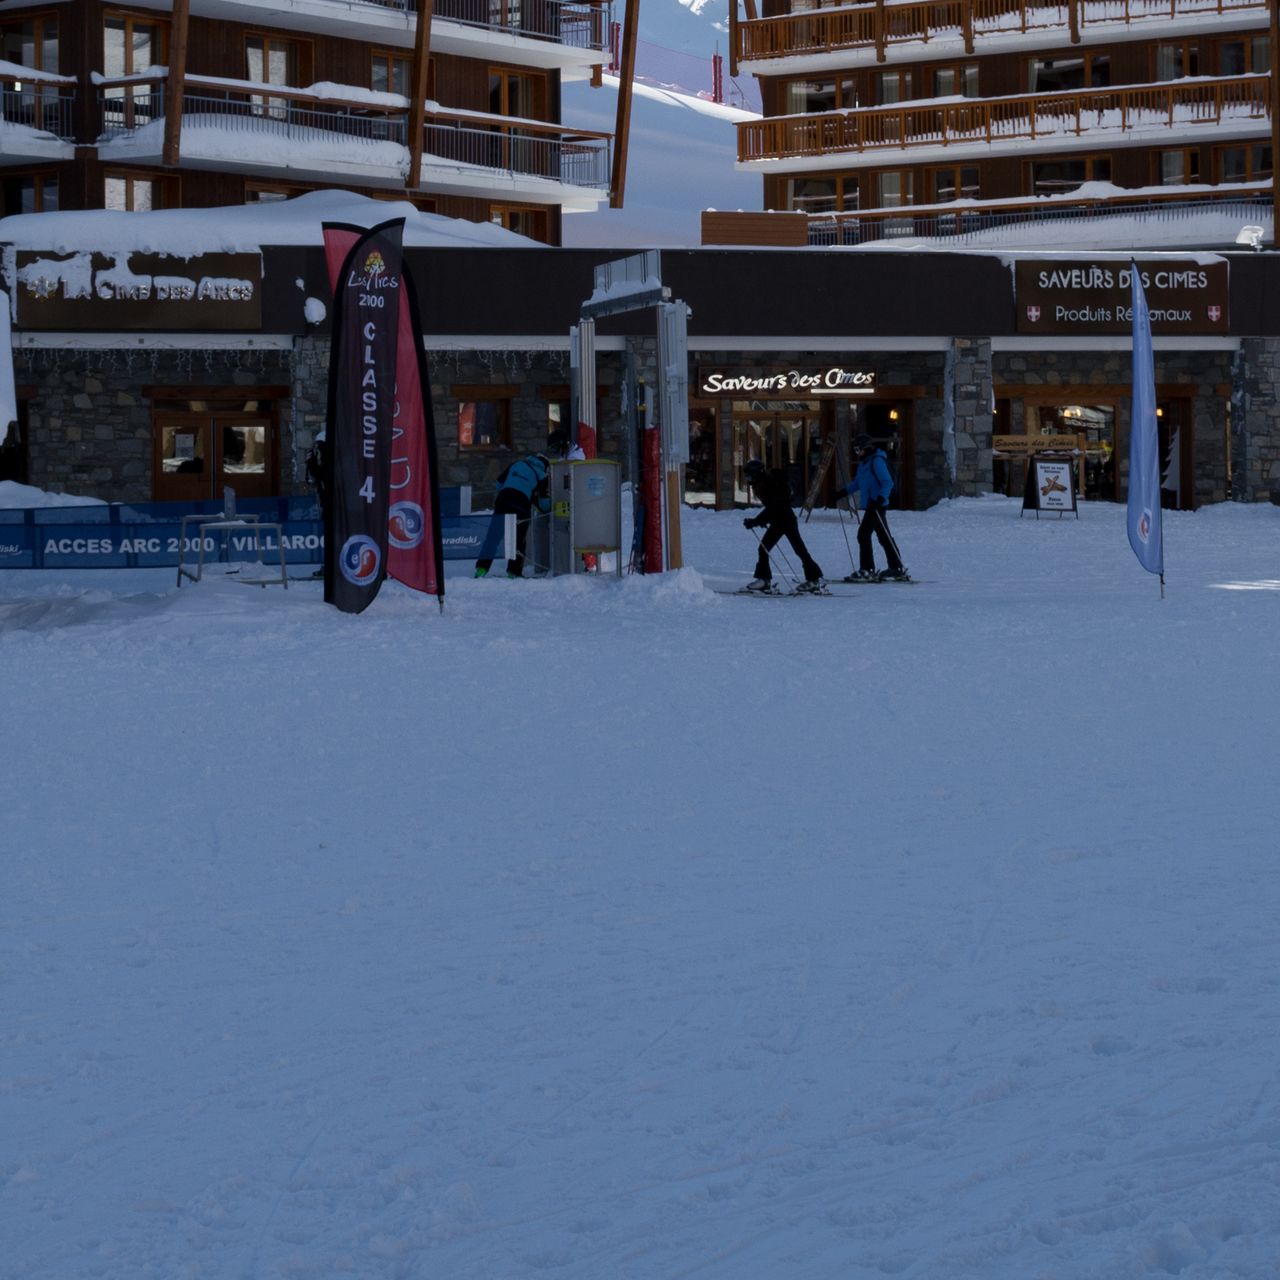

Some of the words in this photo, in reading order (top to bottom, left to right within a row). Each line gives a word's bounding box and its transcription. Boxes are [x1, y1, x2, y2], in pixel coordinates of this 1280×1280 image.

[1038, 269, 1114, 289] SAVEURS
[1118, 269, 1150, 289] DS
[1154, 270, 1208, 289] CIMES
[1055, 305, 1112, 322] Produits
[1116, 305, 1192, 322] Réonaux
[361, 321, 378, 459] CLASSE
[702, 373, 787, 393] Saveurs
[787, 369, 822, 388] des
[358, 475, 376, 504] 4
[44, 538, 113, 555] ACCES
[118, 537, 161, 554] ARC
[166, 536, 215, 553] 2000
[441, 535, 478, 546] aradiski
